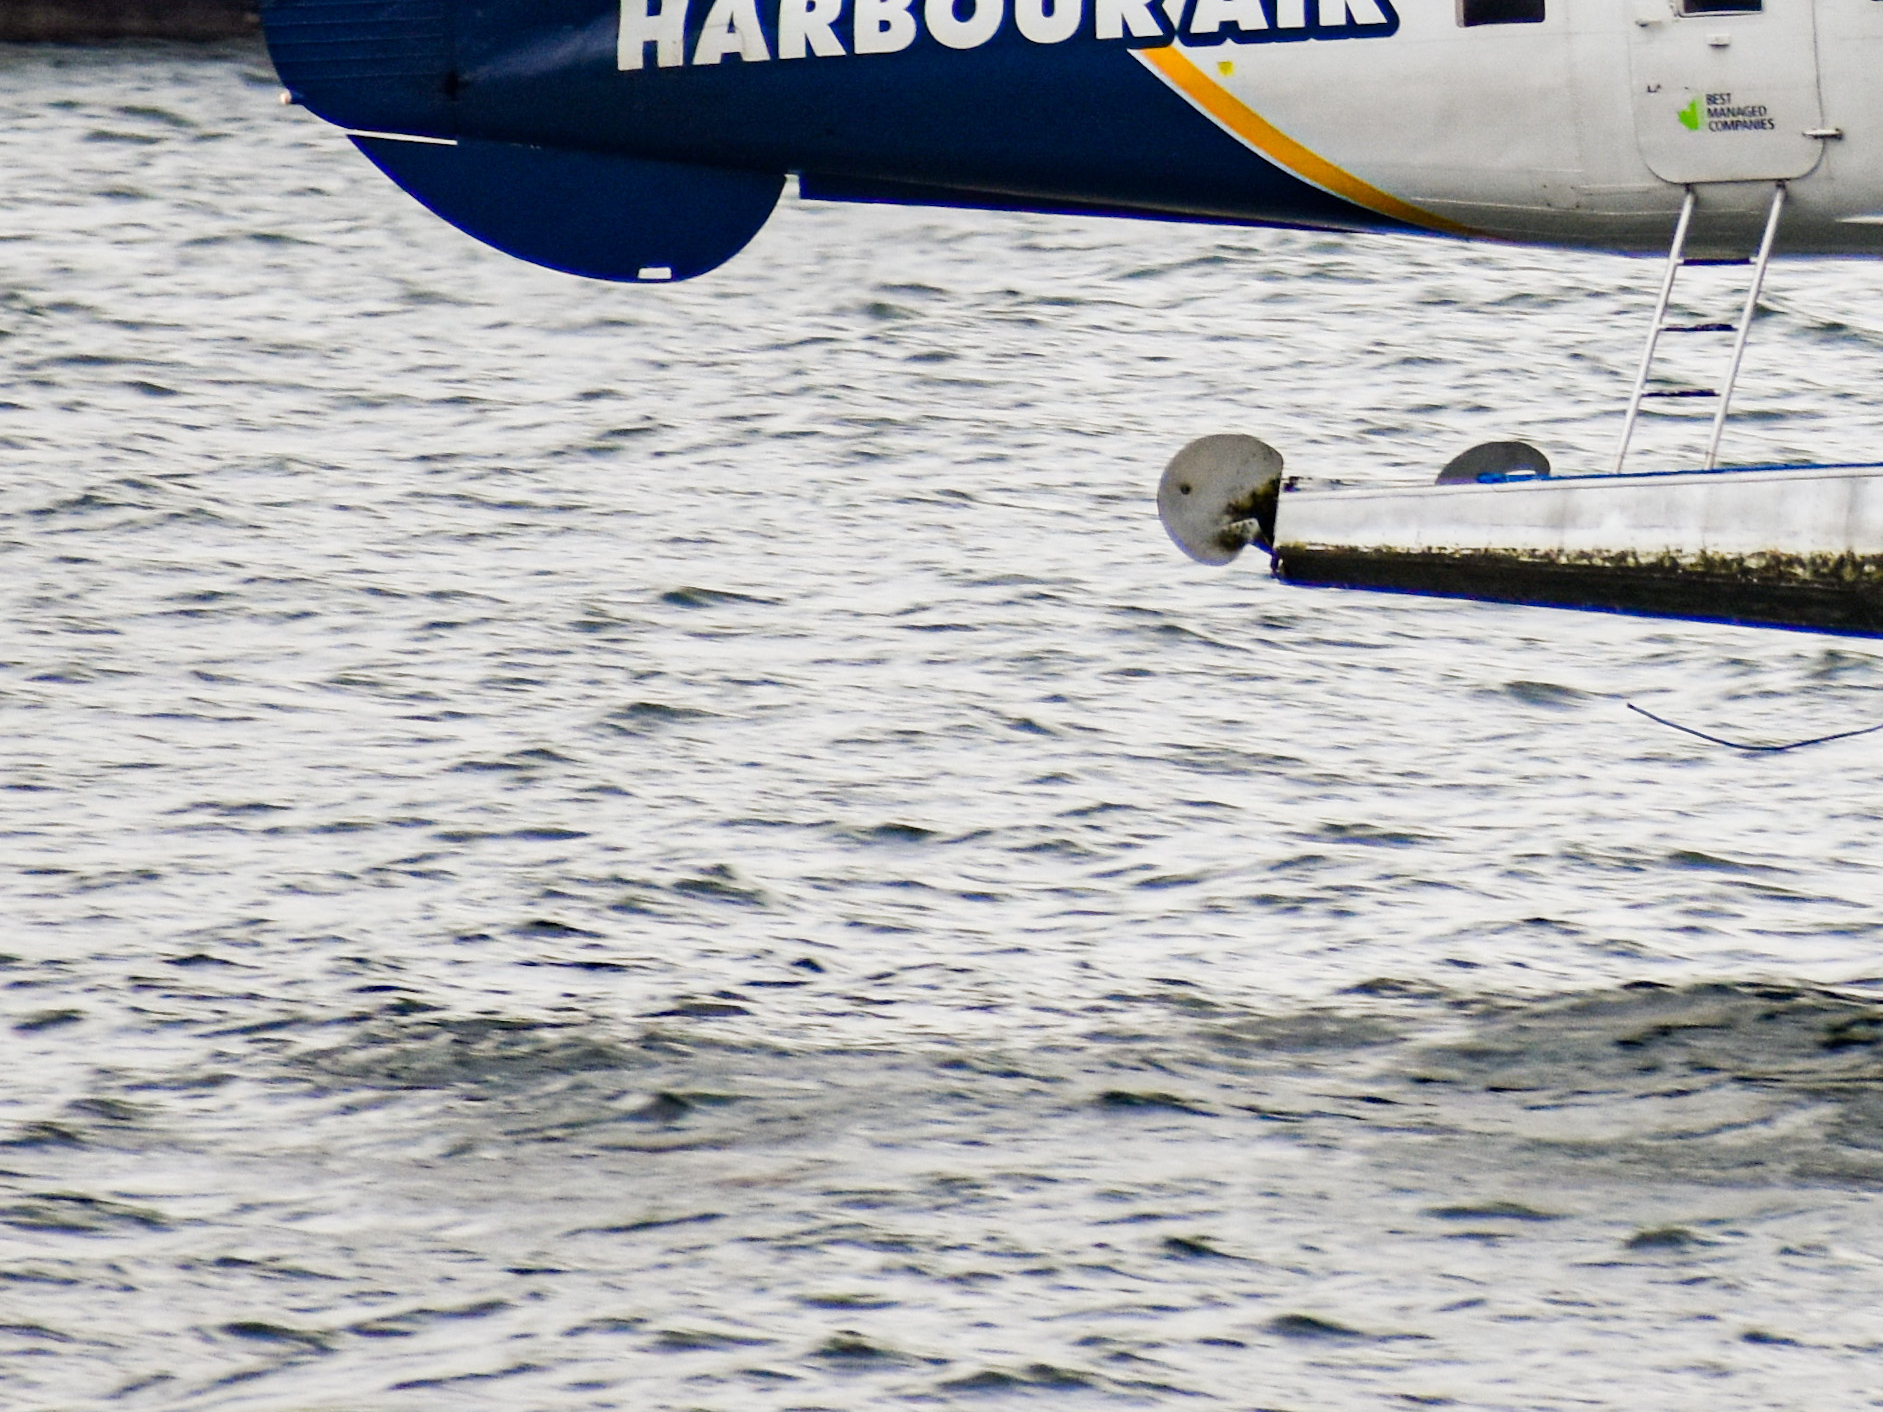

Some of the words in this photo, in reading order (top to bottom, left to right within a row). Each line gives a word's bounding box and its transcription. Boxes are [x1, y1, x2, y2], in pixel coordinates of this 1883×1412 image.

[1706, 93, 1732, 106] BEST
[1707, 106, 1767, 119] MANAGED
[1708, 118, 1775, 132] COMPANIES
